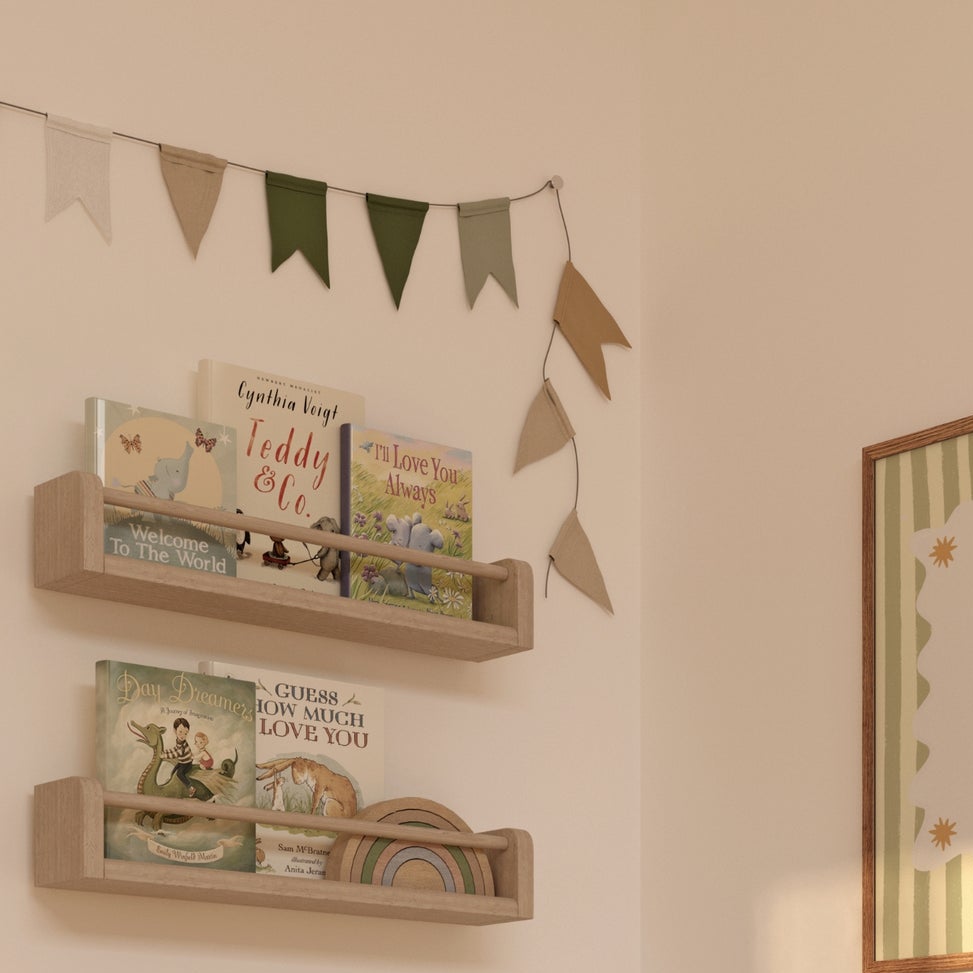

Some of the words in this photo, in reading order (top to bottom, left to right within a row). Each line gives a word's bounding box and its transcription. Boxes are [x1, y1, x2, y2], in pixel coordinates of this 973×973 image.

[238, 381, 296, 411] Cynthia
[303, 395, 338, 428] Voigt
[247, 418, 329, 490] Teddy
[392, 443, 428, 475] Love
[431, 456, 457, 485] You
[385, 472, 437, 509] Always
[128, 522, 209, 553] Welcome
[109, 537, 130, 557] To
[136, 542, 170, 563] The
[175, 549, 226, 574] World
[116, 669, 160, 703] Day
[169, 671, 254, 722] Dreamers
[275, 683, 338, 706] GUESS
[259, 718, 318, 742] LOVE
[323, 726, 369, 749] YOU
[304, 706, 364, 728] MUCH
[278, 843, 294, 852] Sam
[296, 845, 331, 856] McBratne
[284, 865, 304, 874] Anita
